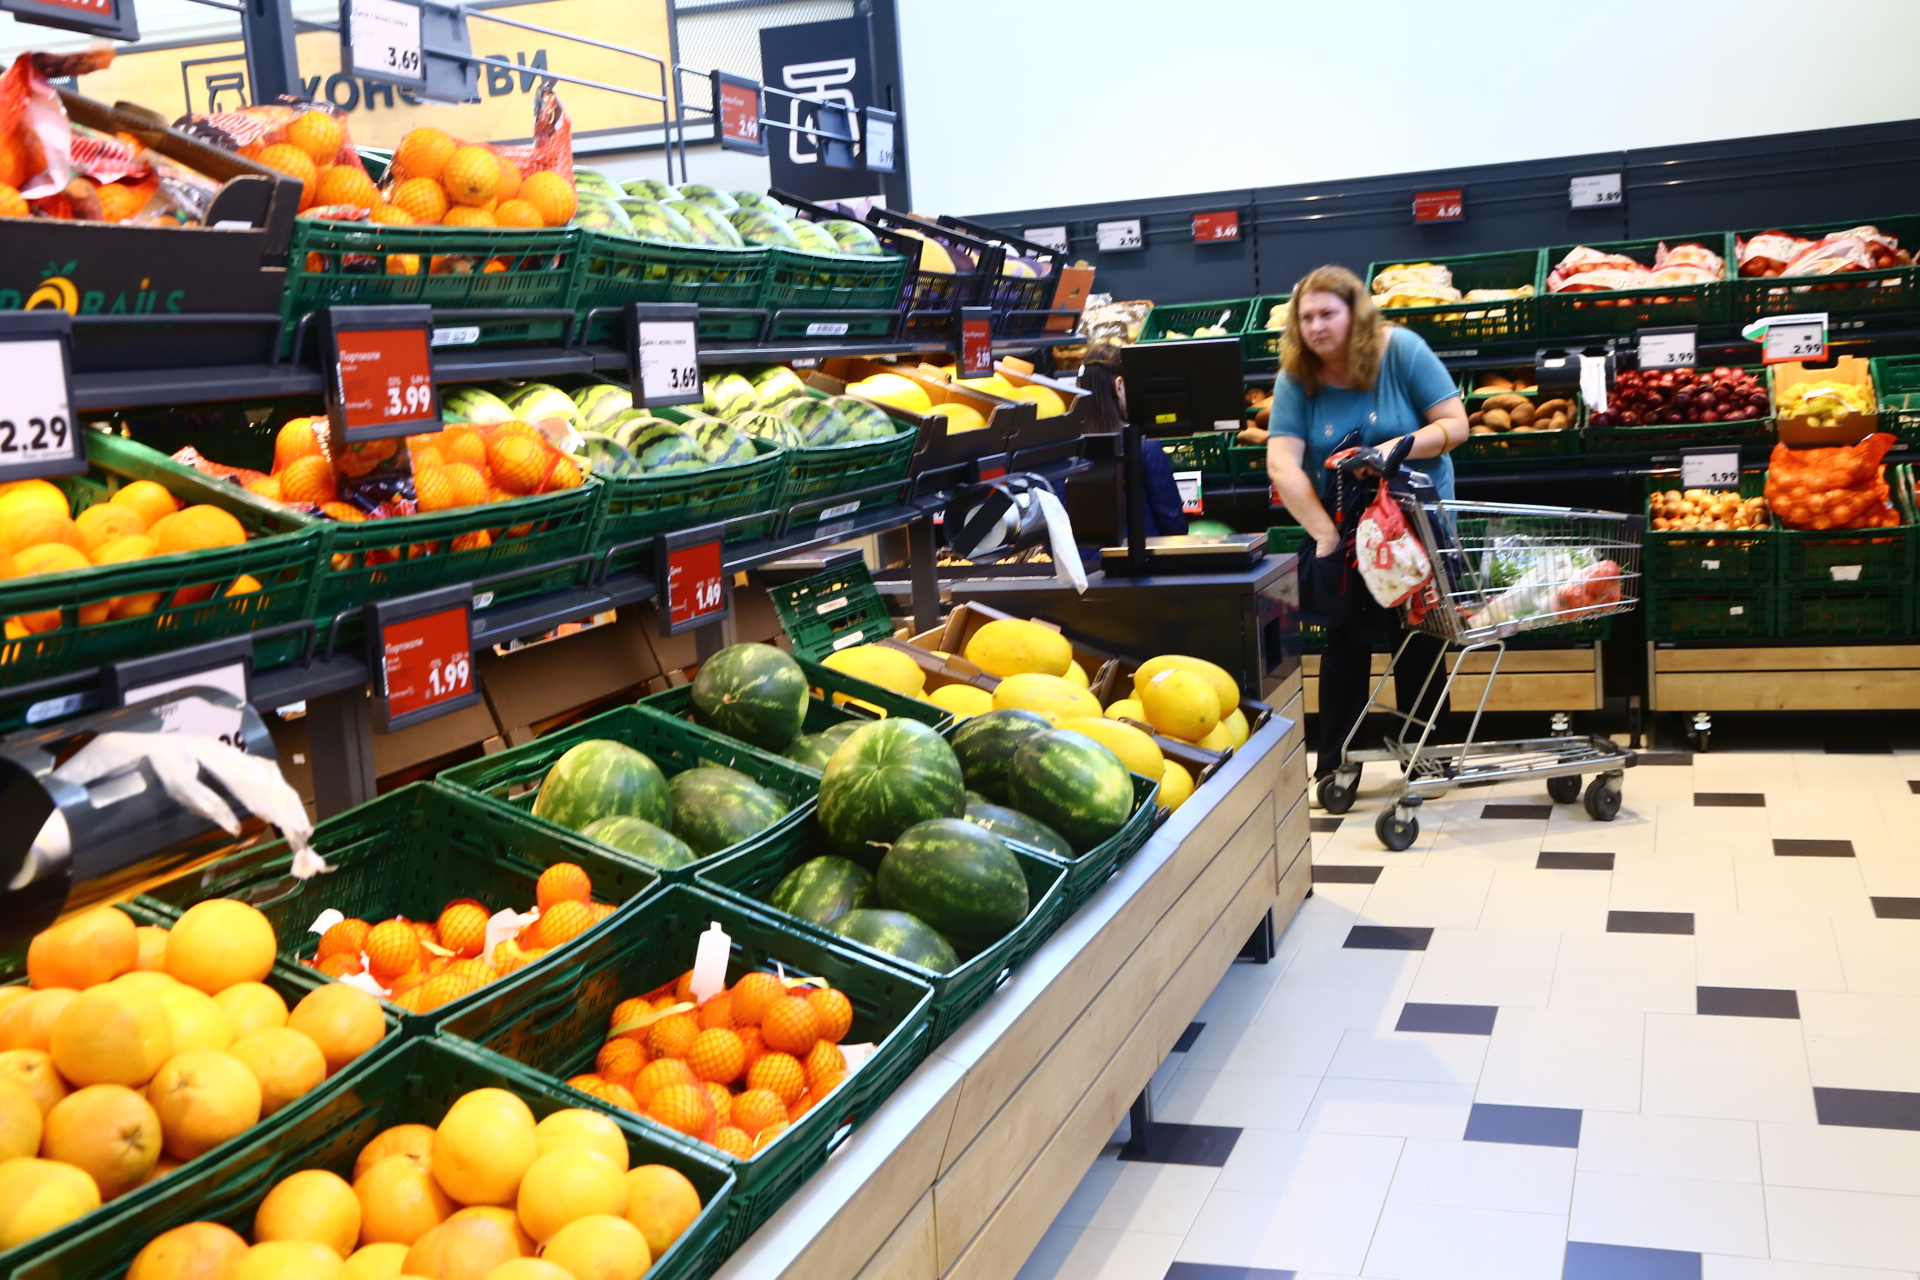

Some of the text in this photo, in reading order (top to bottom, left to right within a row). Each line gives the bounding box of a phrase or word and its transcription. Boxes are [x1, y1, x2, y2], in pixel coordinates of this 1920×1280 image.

[1667, 352, 1694, 362] 3.99
[1793, 343, 1822, 354] 2.99
[387, 384, 431, 416] 3.99
[1711, 472, 1738, 482] 1.99
[696, 582, 722, 610] 1.49
[429, 659, 470, 697] 1.99
